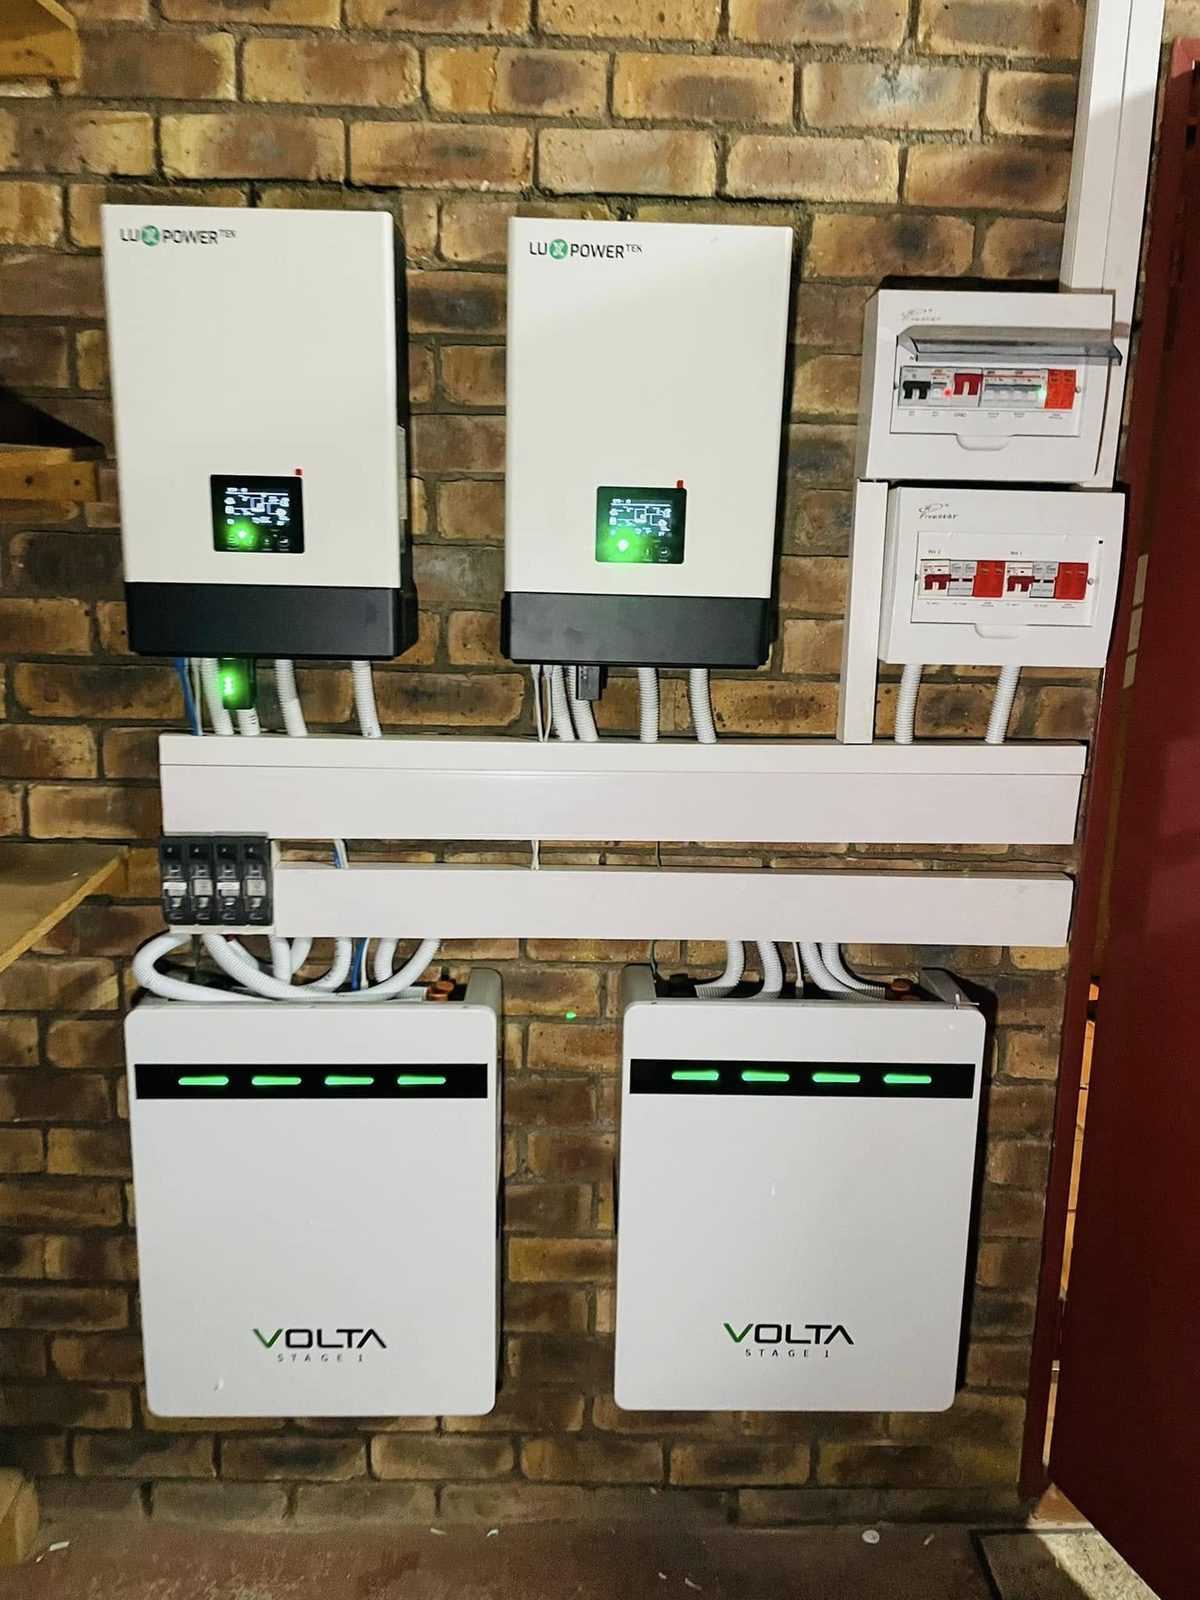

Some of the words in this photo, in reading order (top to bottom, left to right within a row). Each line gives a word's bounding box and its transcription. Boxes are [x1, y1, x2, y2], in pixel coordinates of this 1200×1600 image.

[252, 1328, 387, 1349] VOLTA
[723, 1323, 854, 1345] VOLTA
[277, 1353, 344, 1363] STAGE
[745, 1349, 810, 1358] STAGE
